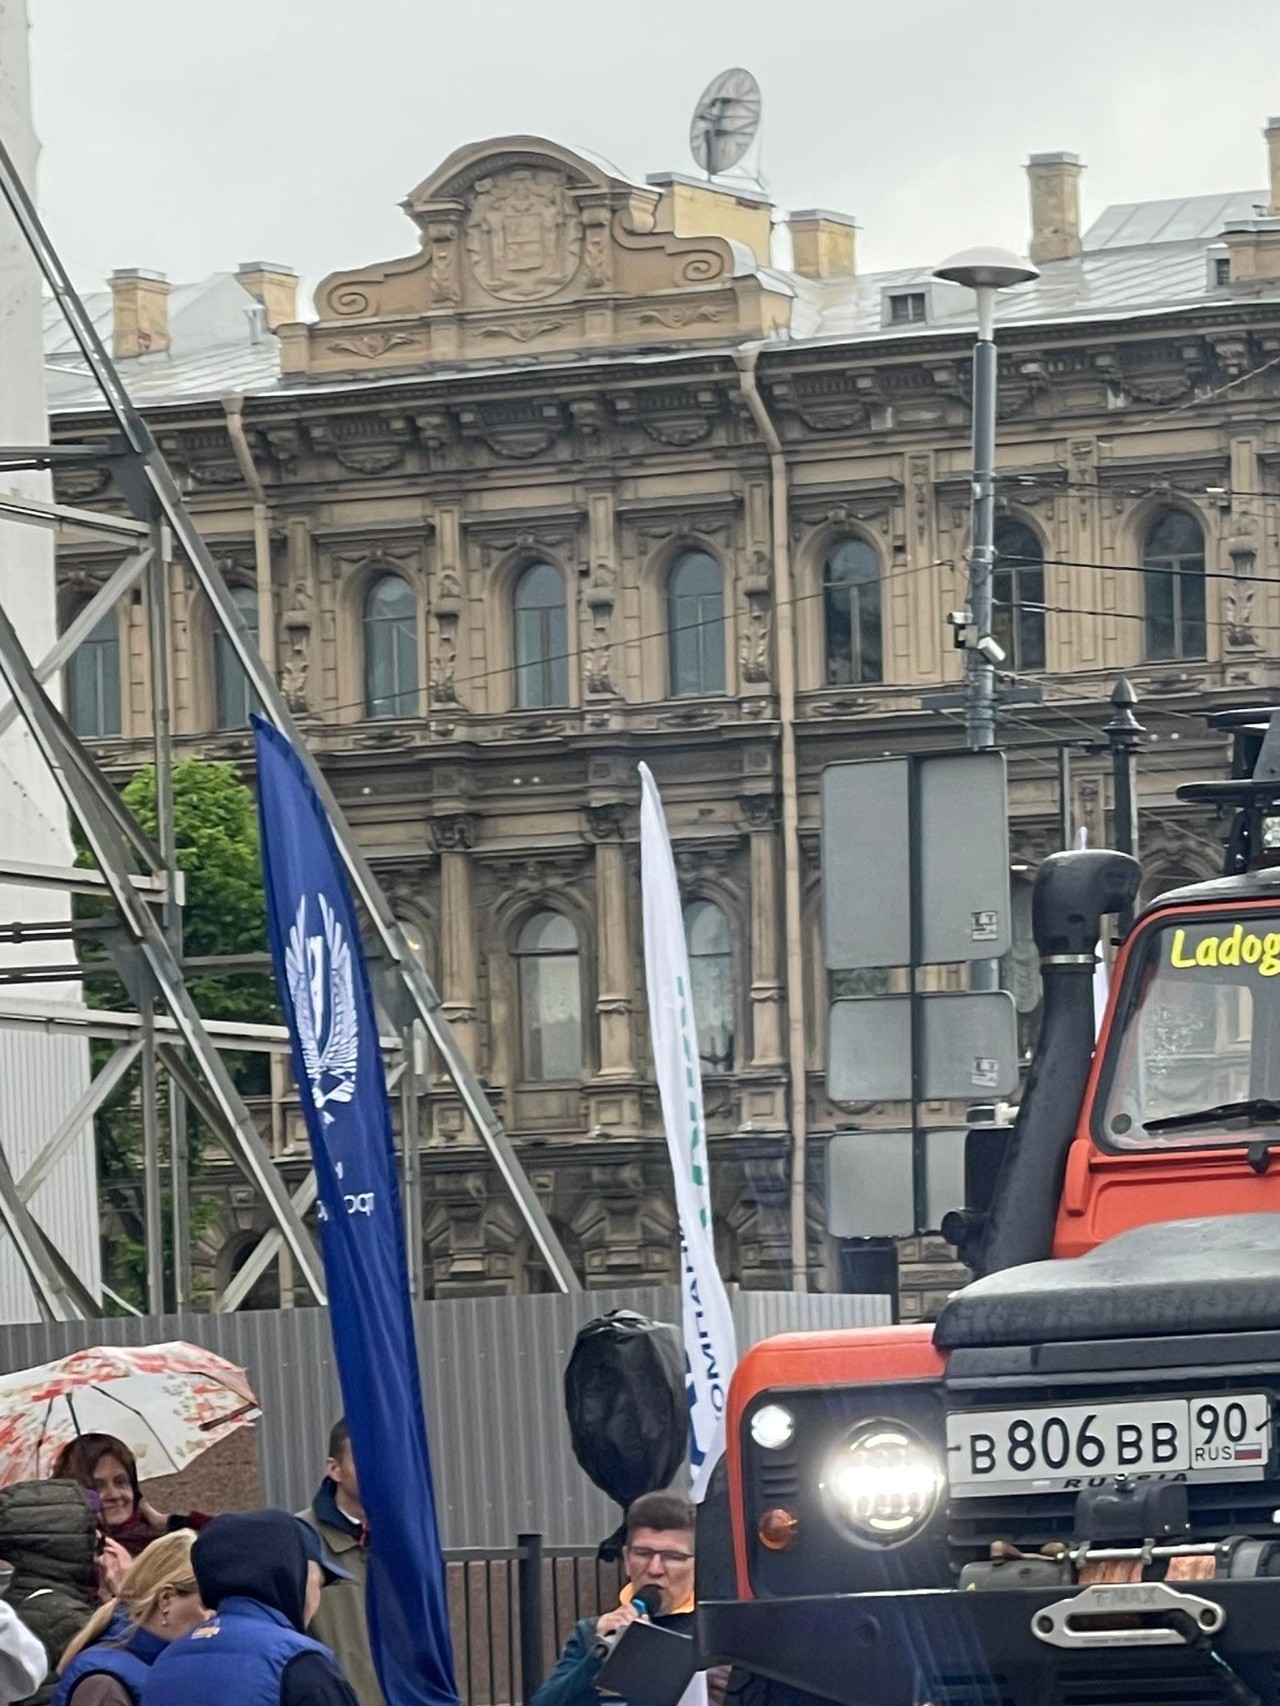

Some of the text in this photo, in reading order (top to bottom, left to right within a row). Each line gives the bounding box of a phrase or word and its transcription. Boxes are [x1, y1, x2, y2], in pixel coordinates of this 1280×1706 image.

[1196, 1402, 1248, 1444] 90
[1194, 1446, 1232, 1462] RUS
[1062, 1472, 1188, 1490] RUSIA
